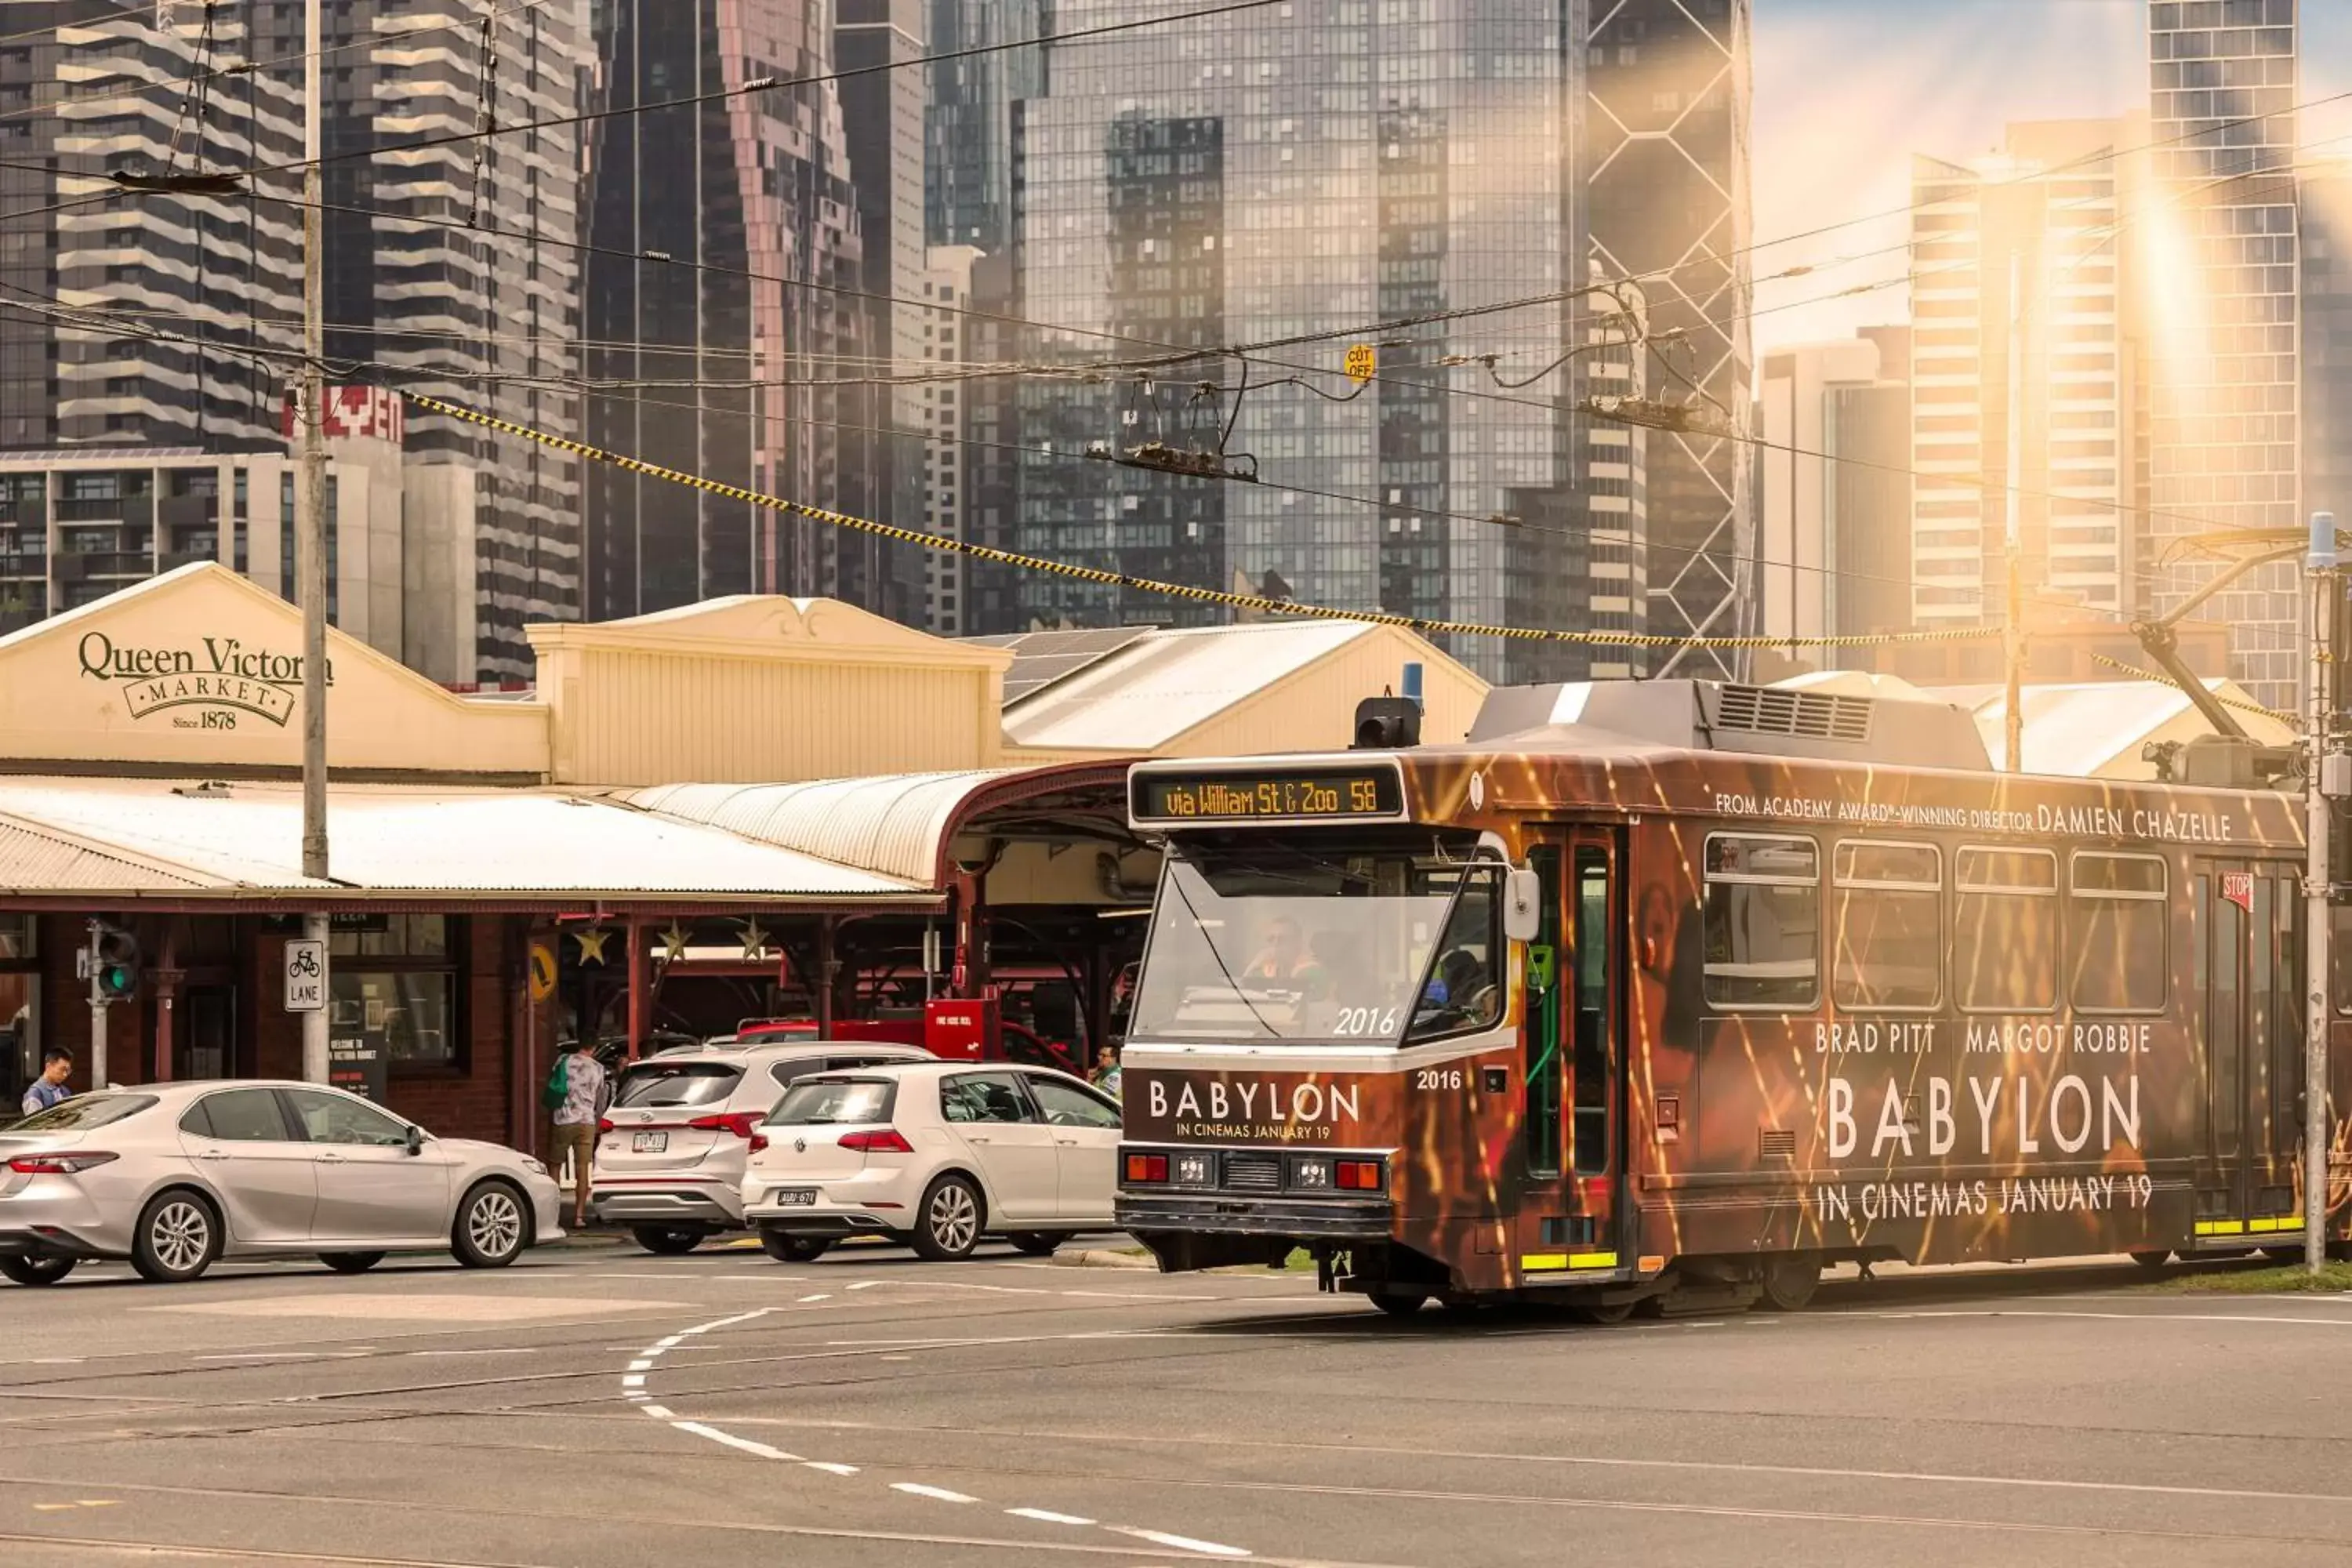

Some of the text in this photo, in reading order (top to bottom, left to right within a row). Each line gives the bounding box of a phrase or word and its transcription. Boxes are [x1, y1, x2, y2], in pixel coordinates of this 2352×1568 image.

[1348, 350, 1370, 362] CUT
[1350, 365, 1371, 376] OFF
[78, 631, 194, 681] Queen
[149, 677, 270, 706] MARKET
[172, 711, 236, 730] Since 1878
[1167, 786, 1195, 815] via
[1199, 784, 1254, 815] William
[1258, 781, 1281, 813] St
[1301, 782, 1338, 812] Zoo
[1351, 781, 1377, 811] 58
[1715, 793, 1757, 815] FROM
[1763, 797, 1832, 818] ACADEMY
[1970, 810, 2033, 831] DIRECTOR
[2038, 804, 2124, 835] DAMIEN
[2132, 810, 2232, 841] CHAZELLE
[2223, 876, 2249, 896] STOP
[291, 985, 318, 1002] LANE
[1334, 1007, 1396, 1036] 2016
[1816, 1023, 2150, 1053] BRAD PITT MARGOT ROBBIE
[1417, 1071, 1461, 1091] 2016
[1150, 1080, 1359, 1122] BABYLON
[1829, 1074, 2140, 1158] BABYLON
[1177, 1123, 1330, 1140] IN CINEMAS JANUARY 19
[1817, 1174, 2153, 1221] IN CINEMAS JANUARY 19
